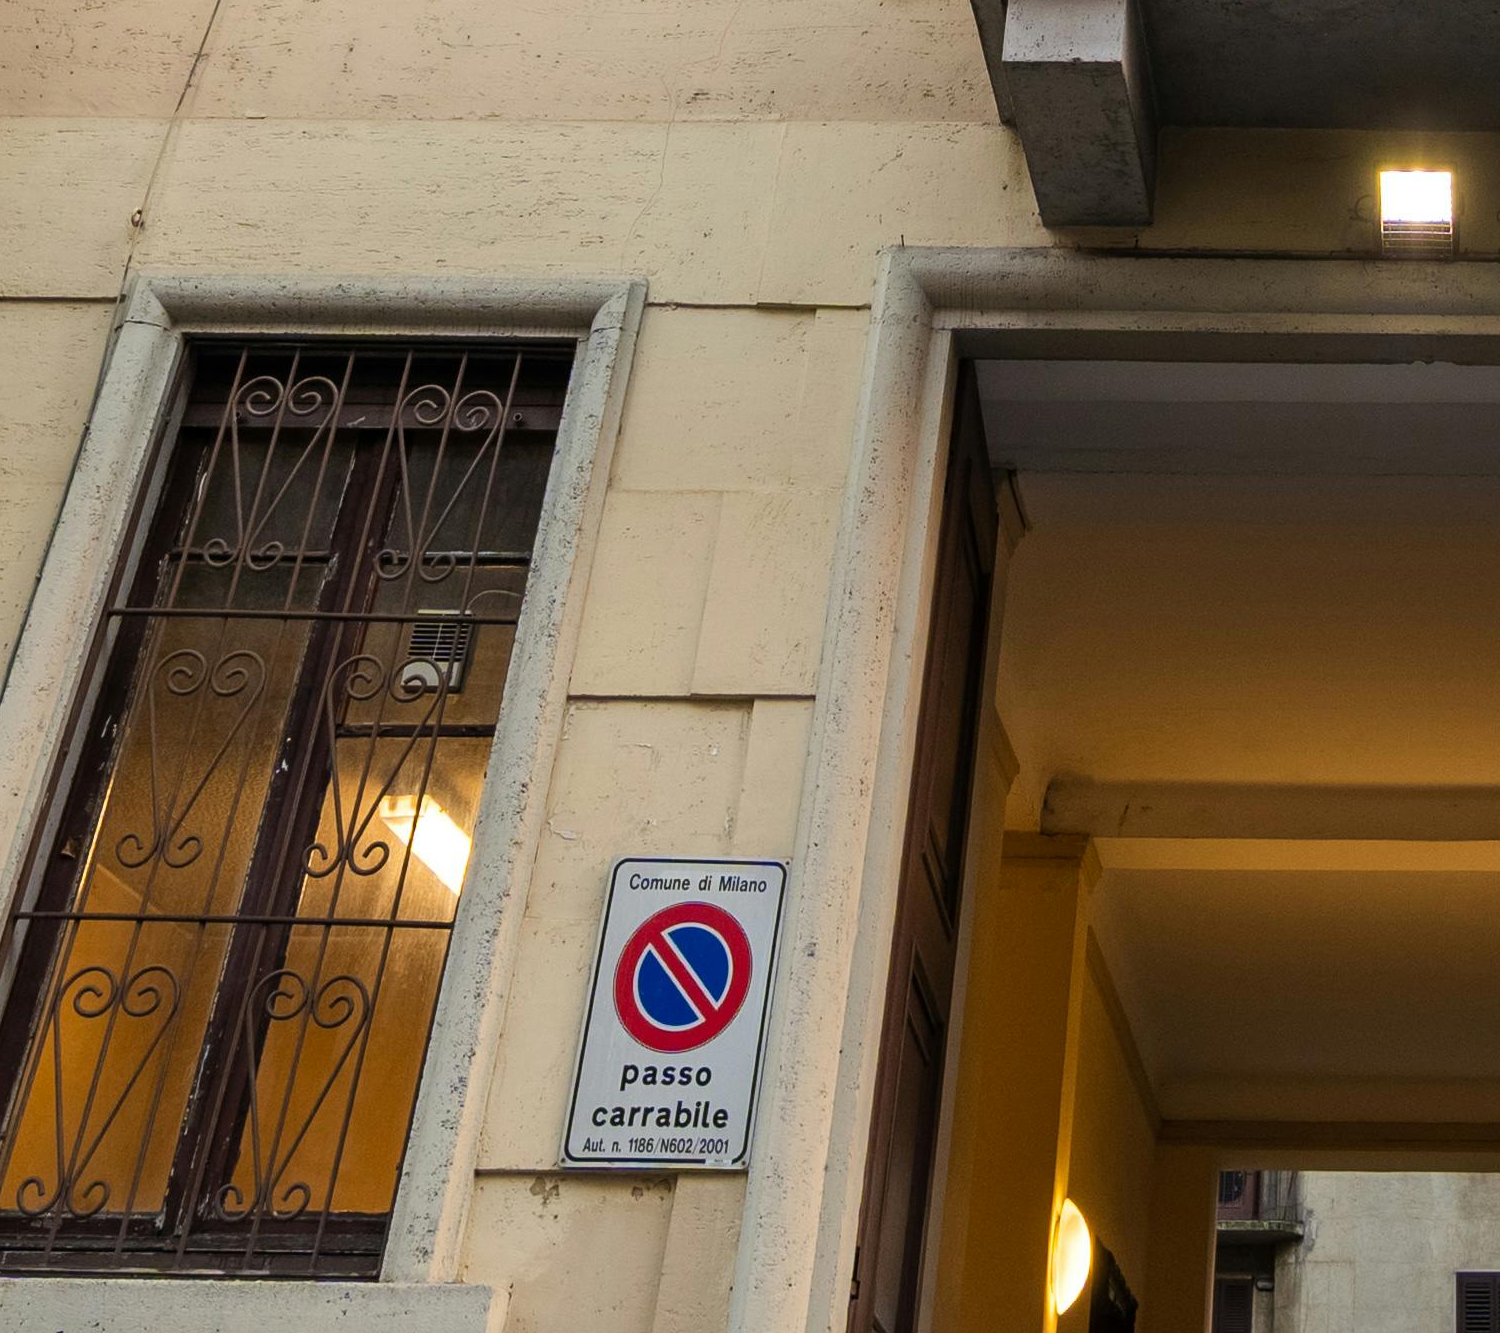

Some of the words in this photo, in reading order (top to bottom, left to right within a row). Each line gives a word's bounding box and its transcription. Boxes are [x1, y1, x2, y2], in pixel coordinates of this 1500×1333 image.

[629, 873, 690, 891] Comune
[698, 875, 712, 892] di
[718, 875, 767, 893] Milano
[619, 1064, 712, 1091] passo
[591, 1101, 729, 1129] carrabile
[582, 1137, 606, 1153] Aut.
[611, 1141, 622, 1153] n.
[628, 1137, 729, 1154] 1186/N602/2001
